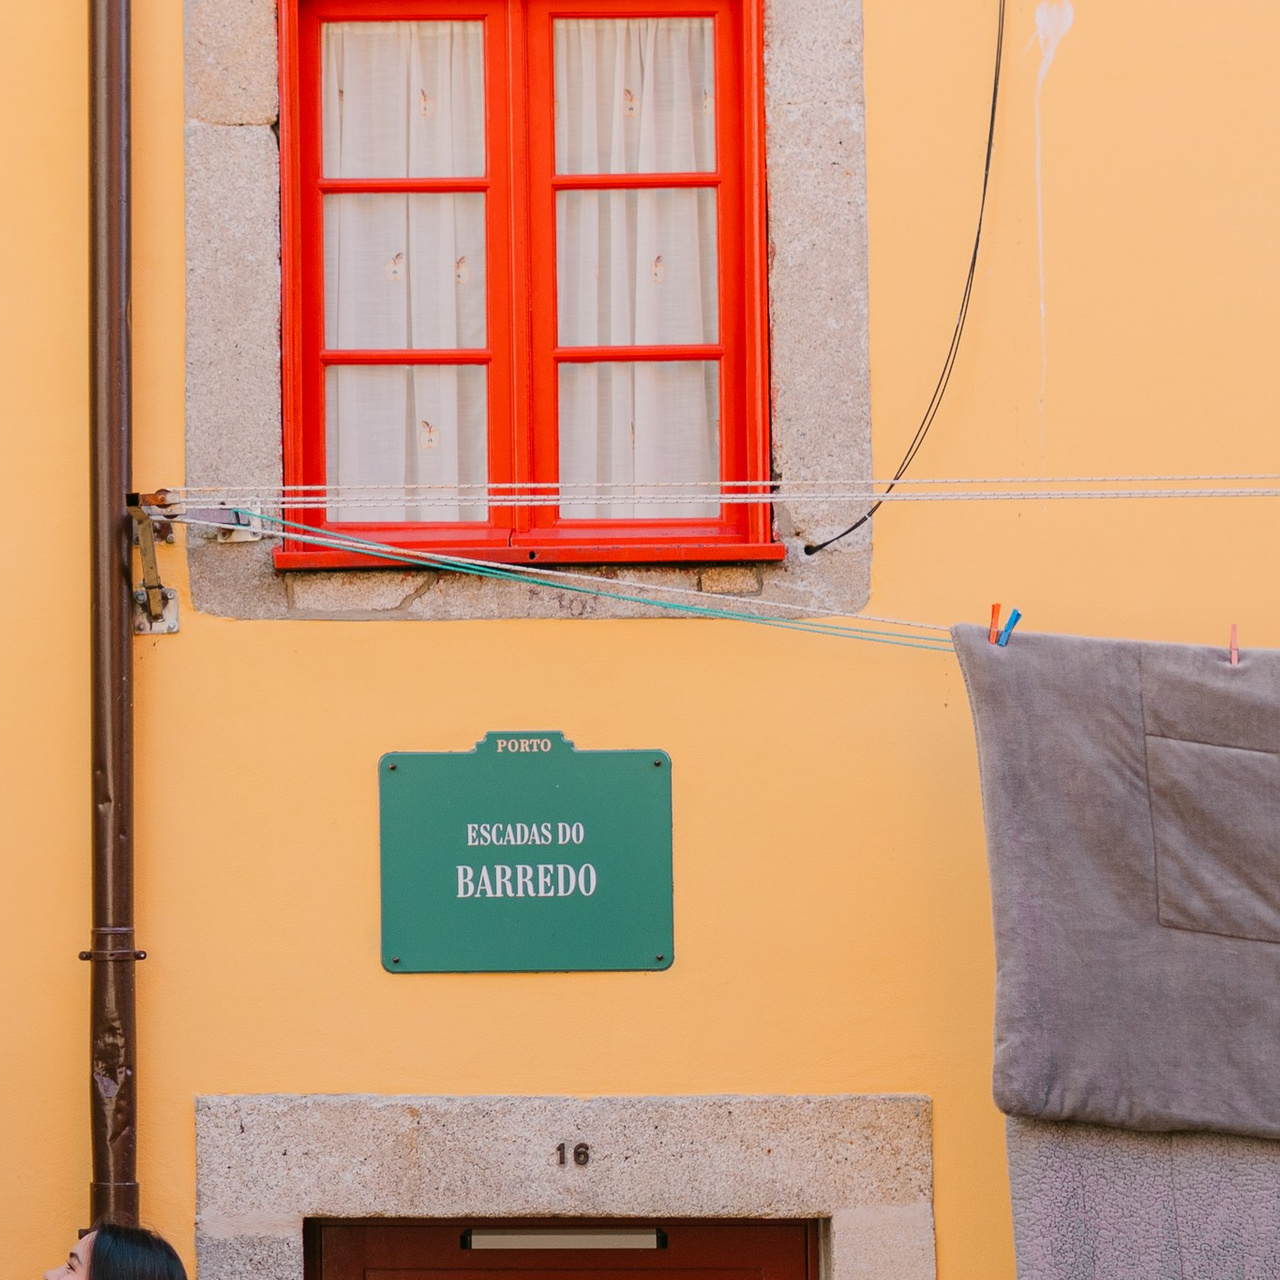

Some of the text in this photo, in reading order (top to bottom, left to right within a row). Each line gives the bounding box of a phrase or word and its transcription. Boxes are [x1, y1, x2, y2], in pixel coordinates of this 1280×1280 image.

[496, 738, 552, 753] PORTO
[467, 821, 585, 846] ESCADAS DO
[456, 863, 597, 898] BARREDO
[556, 1142, 590, 1166] 16
